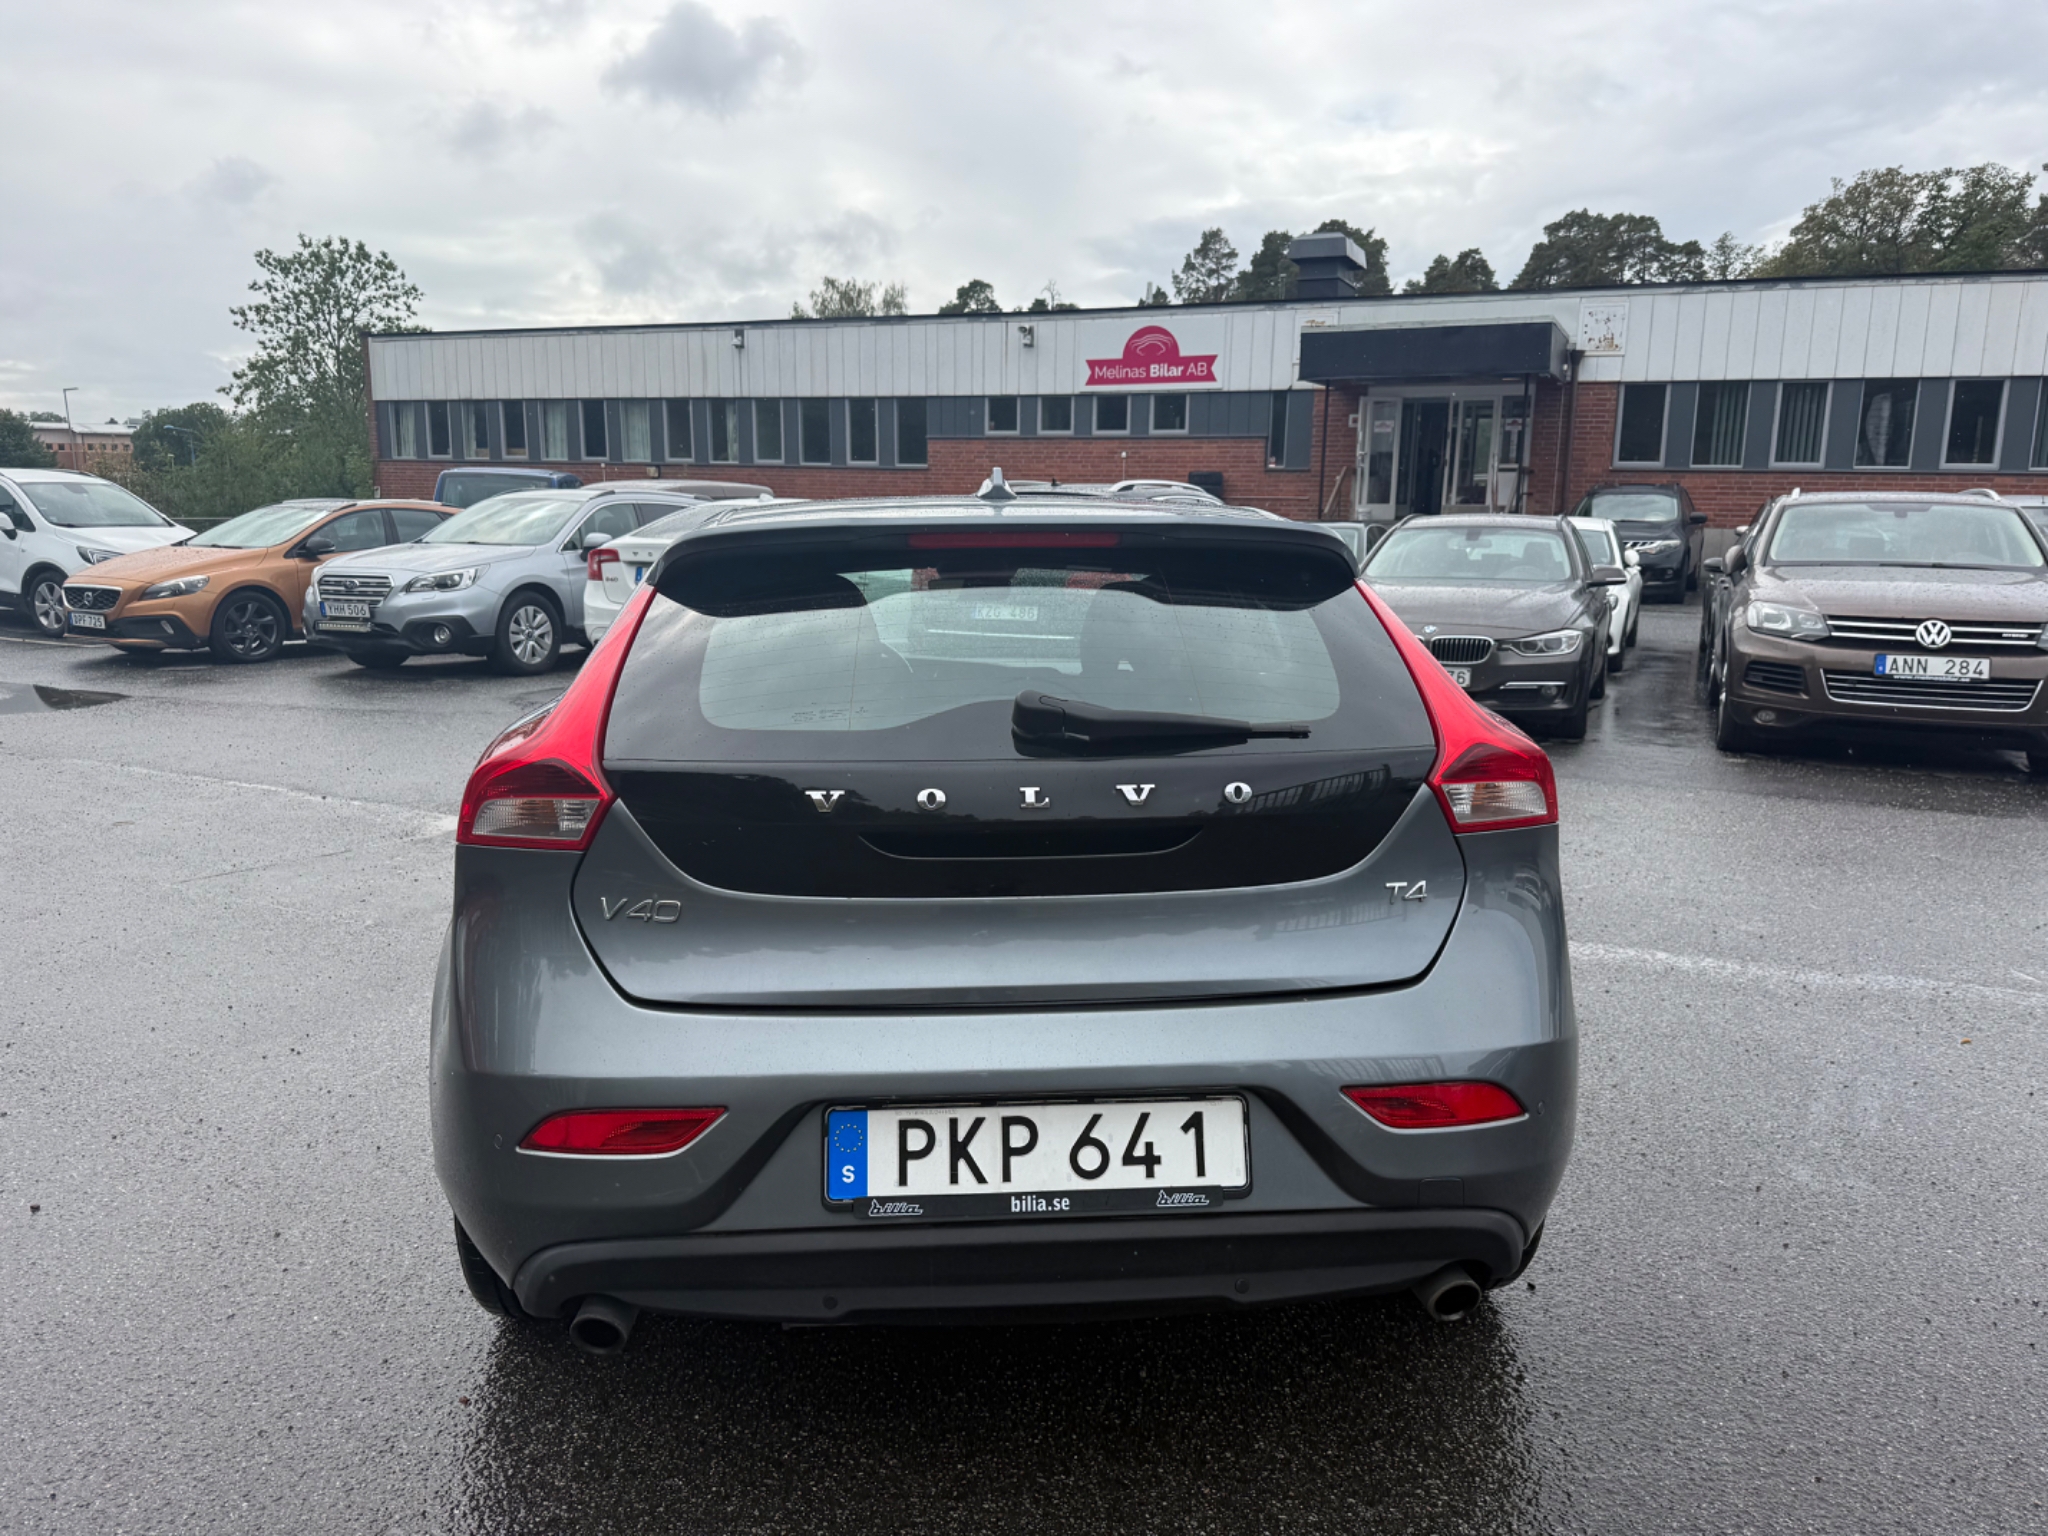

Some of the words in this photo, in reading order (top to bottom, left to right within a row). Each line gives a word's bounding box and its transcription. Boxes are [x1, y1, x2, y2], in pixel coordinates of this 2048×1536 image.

[1095, 364, 1146, 379] Melinas
[1150, 363, 1184, 378] Bilar
[1186, 362, 1207, 376] AB
[327, 603, 346, 615] YHH
[347, 604, 367, 616] 506
[1888, 656, 1929, 674] ANN
[1944, 658, 1985, 677] 284
[804, 781, 1254, 813] VOLVO
[1384, 880, 1428, 905] T4
[600, 896, 682, 923] V40
[897, 1115, 1039, 1187] PKP
[1069, 1110, 1207, 1181] 641
[841, 1164, 856, 1184] S
[868, 1199, 923, 1217] bilia
[1010, 1195, 1071, 1213] bilia.se
[1156, 1189, 1210, 1207] bilia
